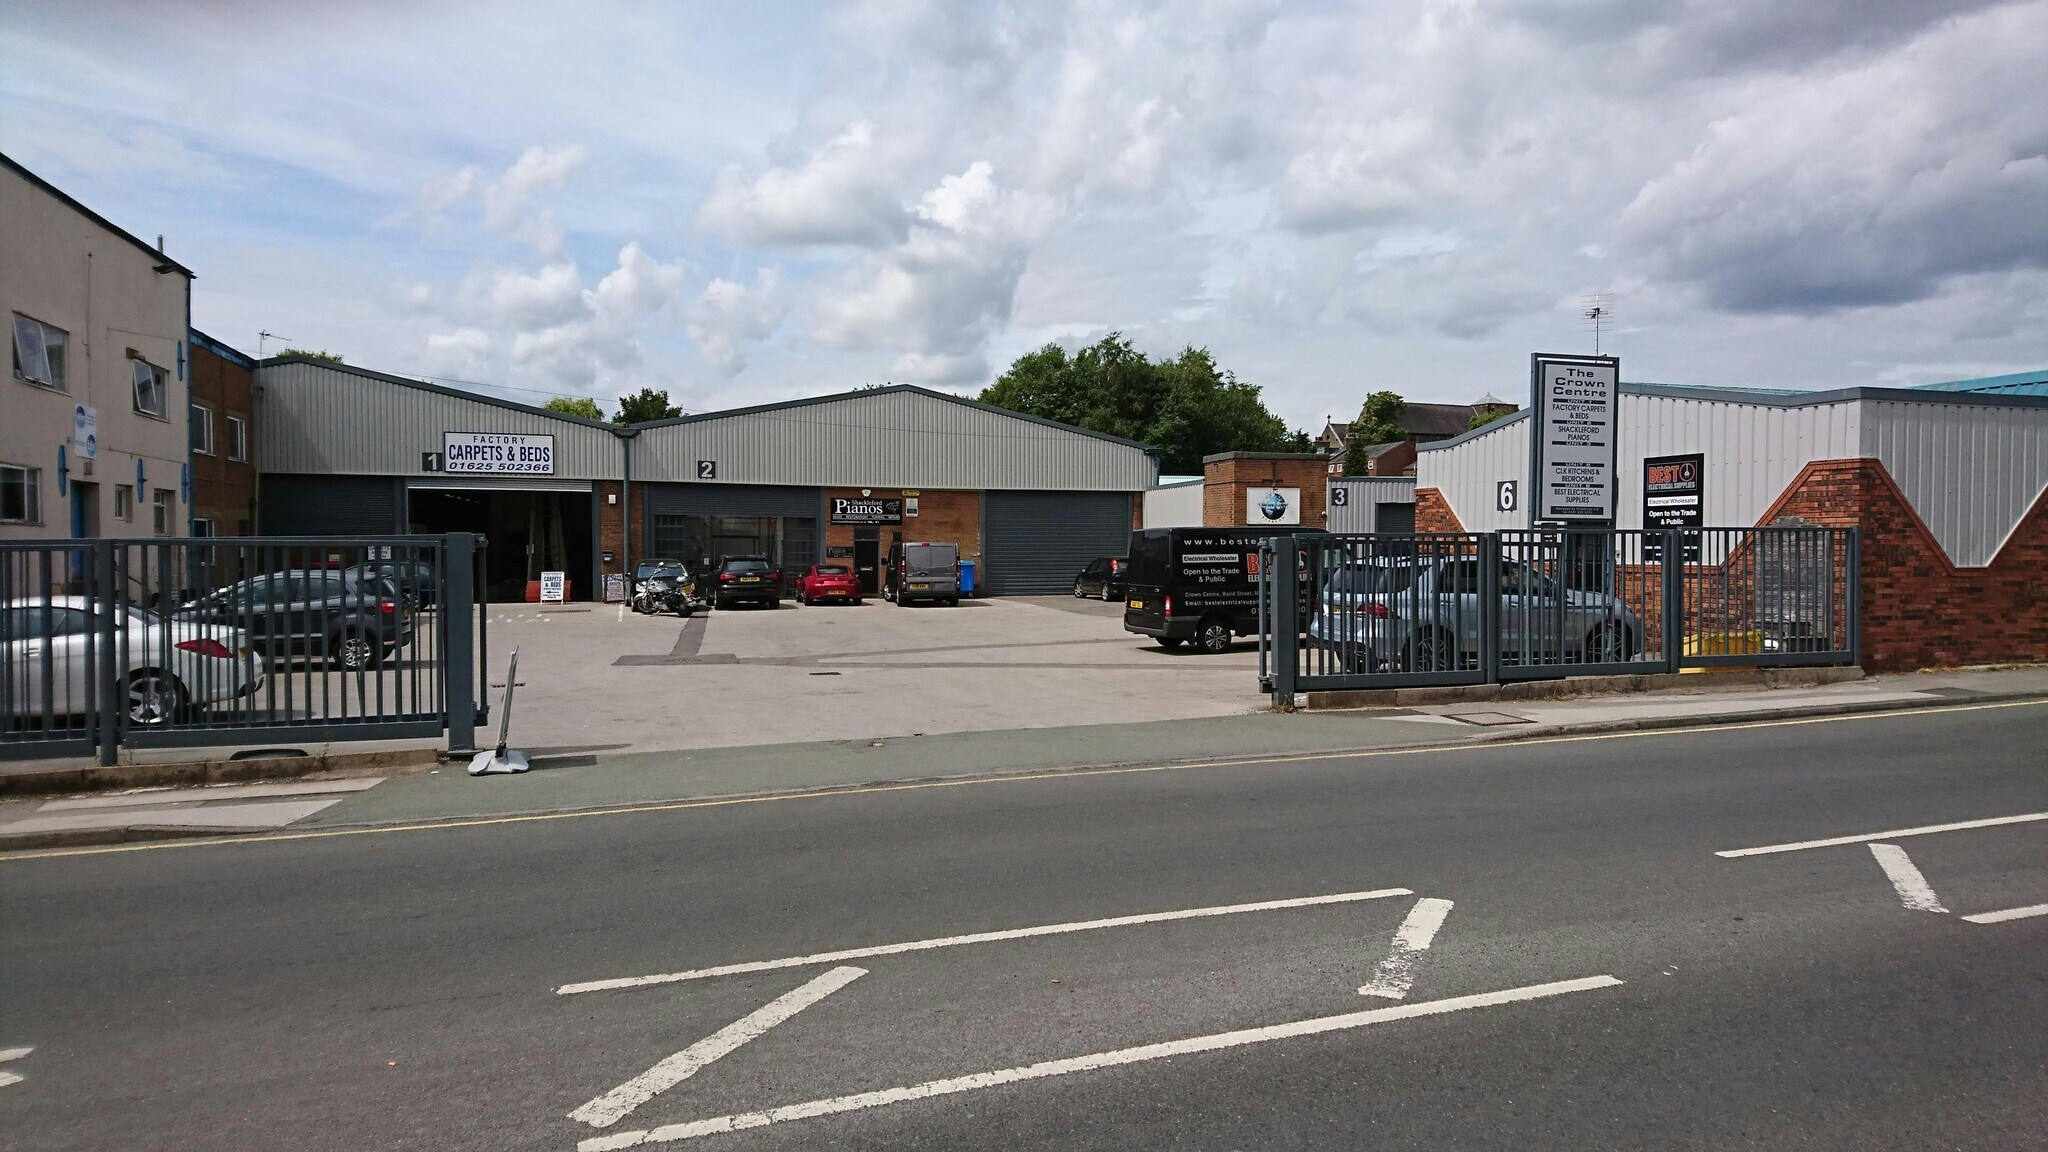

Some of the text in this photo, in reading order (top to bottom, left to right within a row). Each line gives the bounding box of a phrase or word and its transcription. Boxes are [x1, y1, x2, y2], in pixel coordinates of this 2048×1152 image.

[1567, 368, 1594, 378] The
[1555, 377, 1605, 388] Crown
[1553, 387, 1607, 398] Centre
[1552, 404, 1606, 413] FACTORY CARPETS
[1558, 426, 1600, 434] SHACKLEFORD
[473, 436, 526, 444] FACTORY
[449, 444, 550, 462] CARPETS & BEDS
[428, 454, 437, 470] 1
[449, 462, 550, 472] 01625 502366
[701, 461, 713, 478] 2
[1648, 466, 1679, 483] BEST
[1674, 481, 1696, 489] SUPPLIES
[1335, 488, 1345, 505] 3
[1500, 482, 1514, 510] 6
[834, 499, 883, 514] Pianos
[1648, 510, 1664, 518] Open
[1183, 568, 1201, 577] Open
